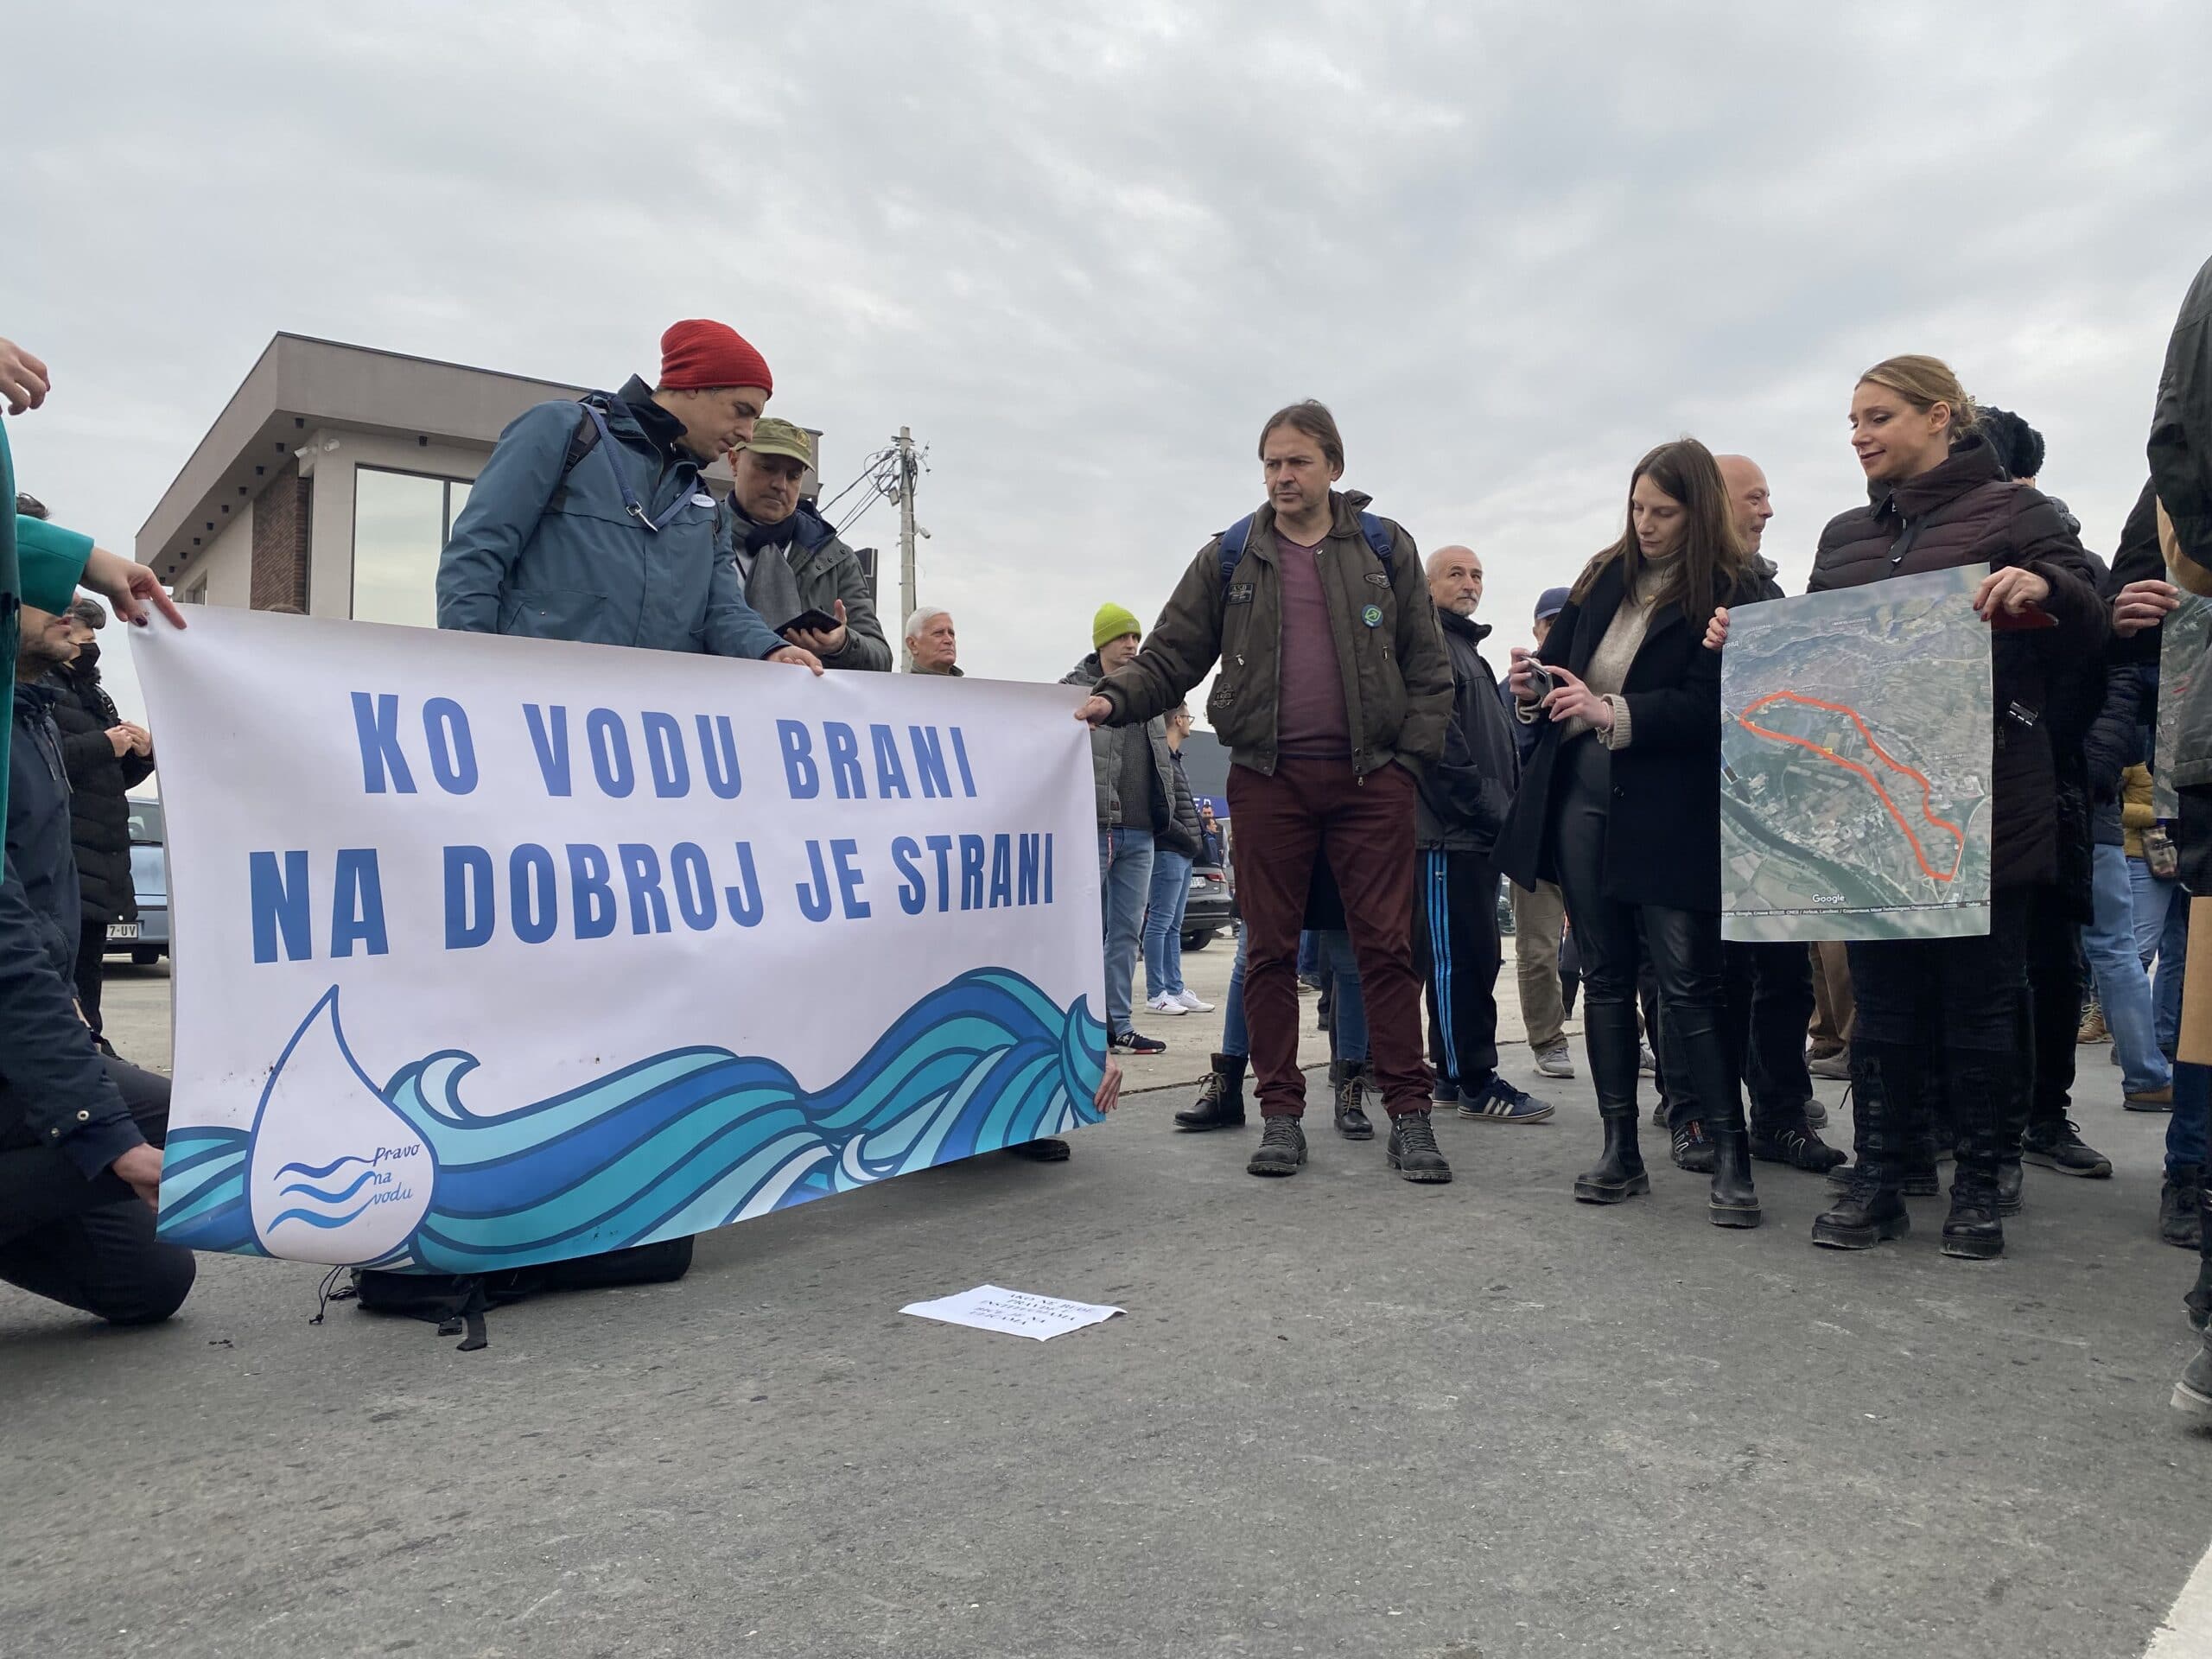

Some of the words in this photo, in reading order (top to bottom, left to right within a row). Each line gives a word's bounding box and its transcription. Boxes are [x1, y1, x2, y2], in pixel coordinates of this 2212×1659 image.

[351, 691, 478, 795] KO
[523, 704, 741, 799] VODU
[777, 719, 976, 799] BRANI
[250, 848, 388, 964] NA
[442, 842, 764, 950] DOBROJ
[797, 839, 871, 923] JE
[891, 832, 1053, 916] STRANI
[1812, 893, 1845, 904] Google
[373, 1172, 391, 1185] na
[373, 1181, 412, 1205] vodu
